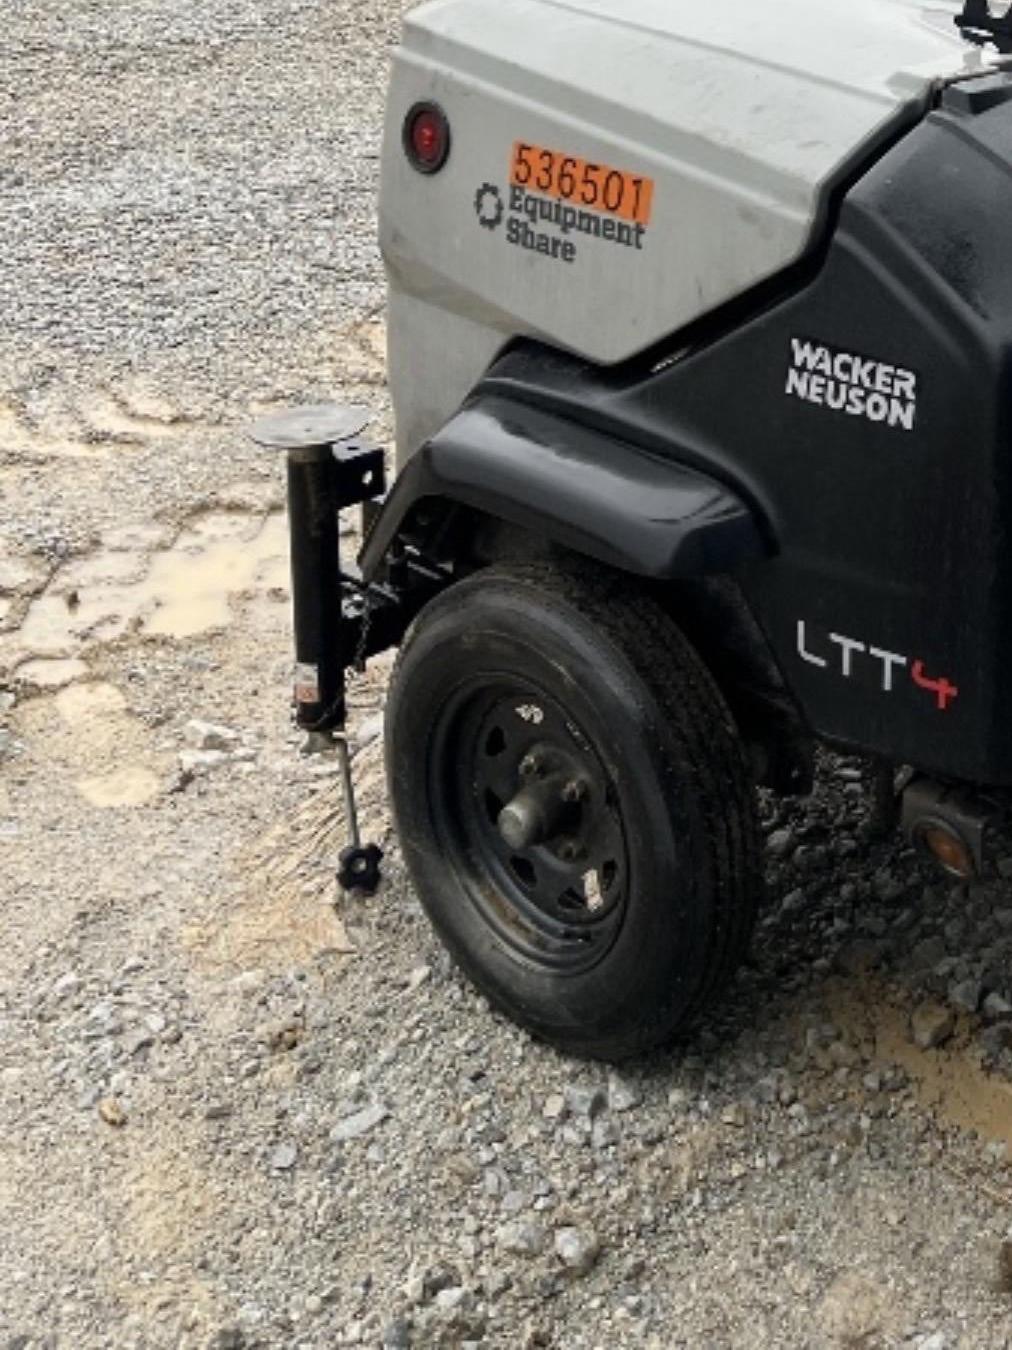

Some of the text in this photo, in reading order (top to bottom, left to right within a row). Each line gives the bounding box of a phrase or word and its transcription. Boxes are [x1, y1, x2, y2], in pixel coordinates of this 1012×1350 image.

[513, 143, 643, 219] 536501
[505, 215, 576, 263] Share
[508, 186, 646, 250] Equipment
[785, 367, 916, 430] NEUSON
[791, 337, 916, 401] WACKER
[797, 619, 958, 710] LTT4
